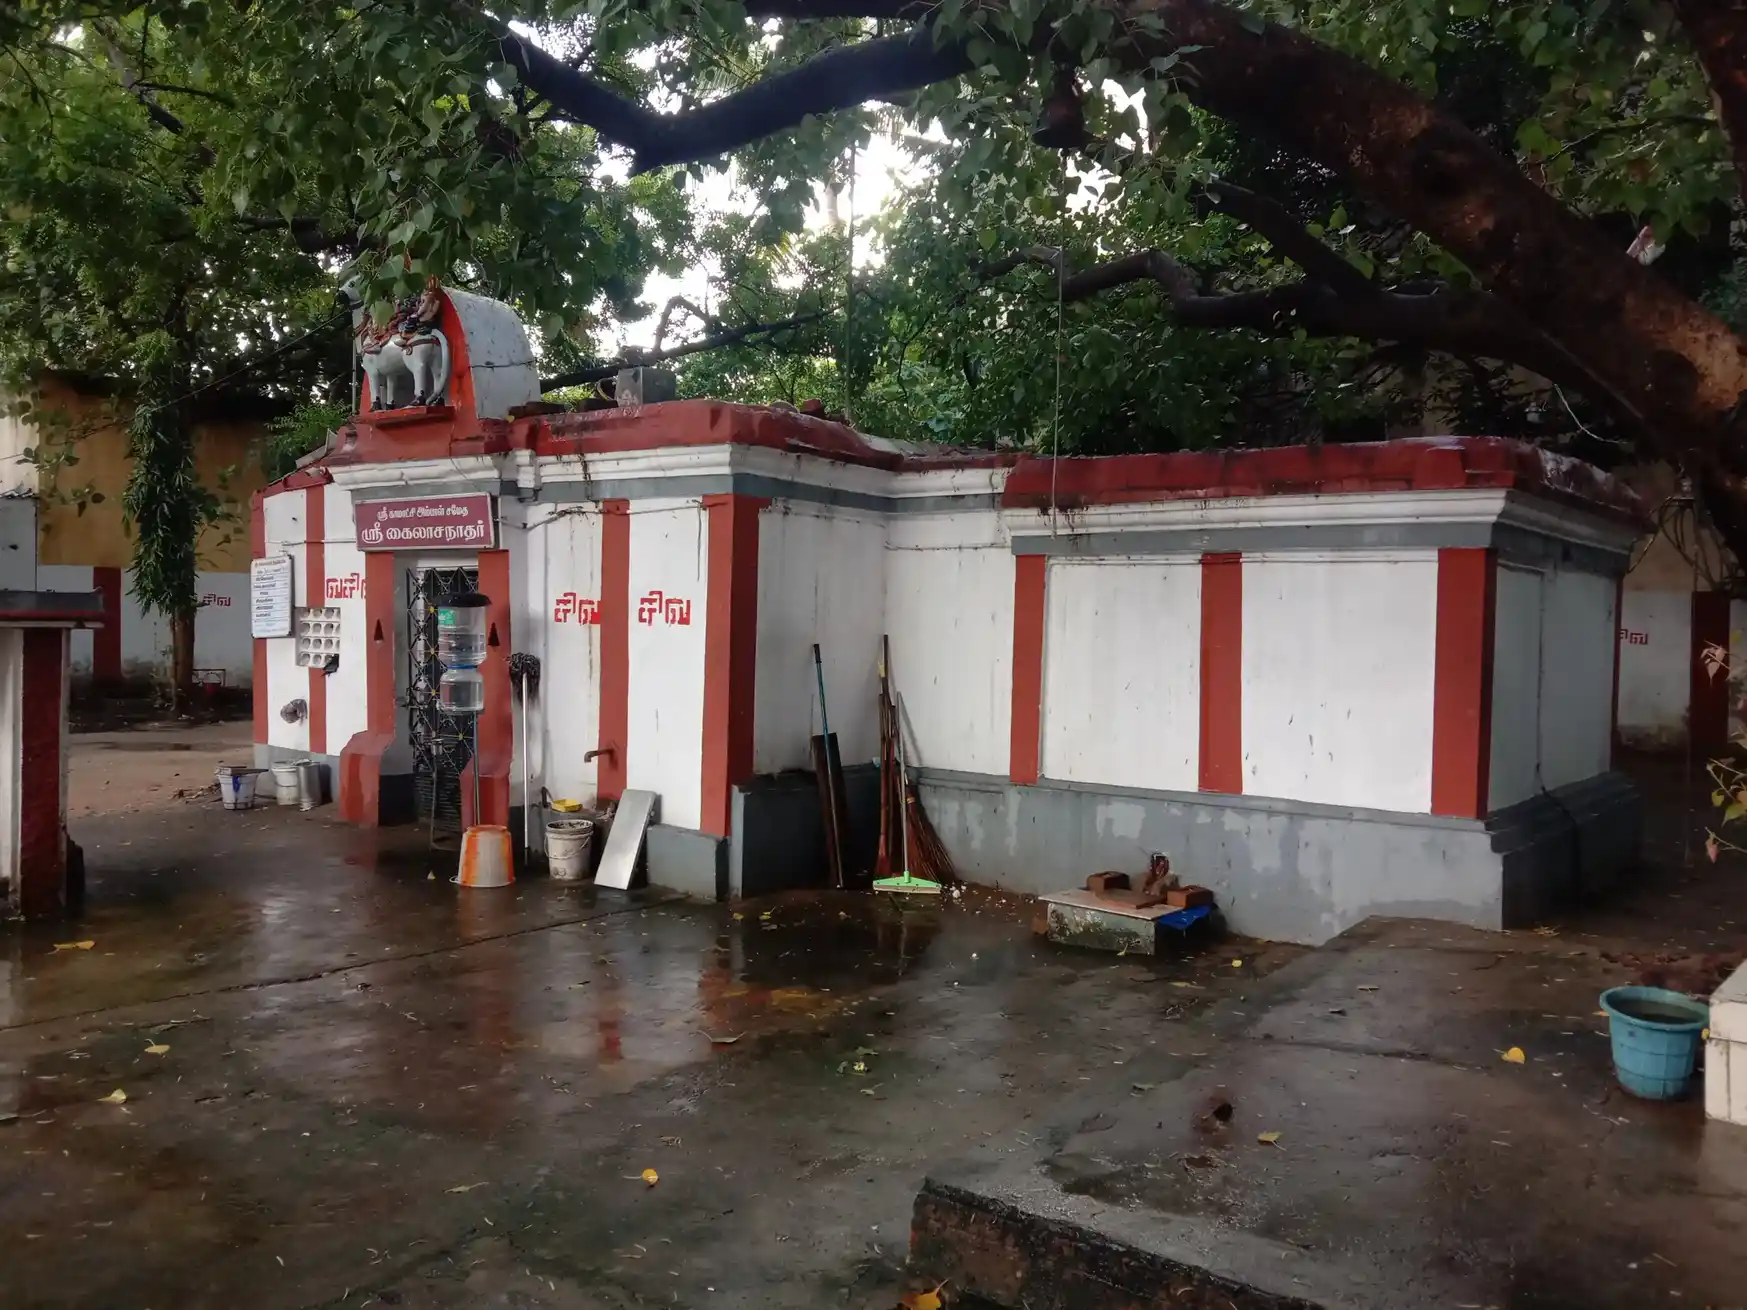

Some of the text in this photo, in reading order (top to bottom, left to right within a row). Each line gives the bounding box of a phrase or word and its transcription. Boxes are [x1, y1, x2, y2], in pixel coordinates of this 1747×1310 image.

[361, 519, 486, 544] ஸ்ரீ கைலாசநாதர்
[638, 590, 691, 626] சிவ
